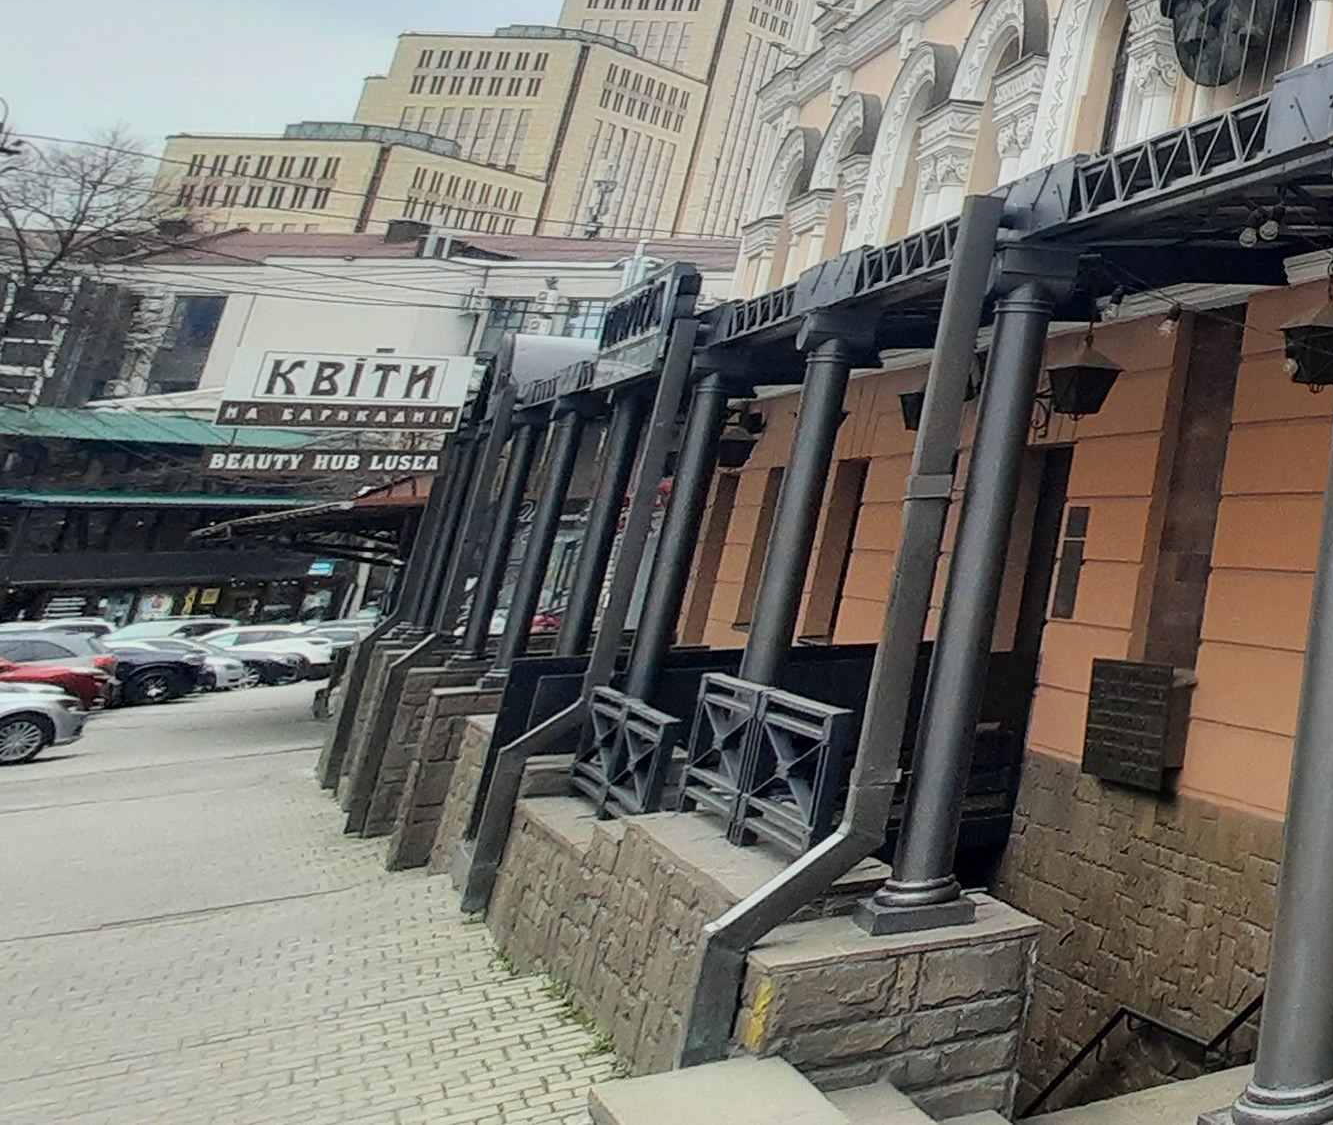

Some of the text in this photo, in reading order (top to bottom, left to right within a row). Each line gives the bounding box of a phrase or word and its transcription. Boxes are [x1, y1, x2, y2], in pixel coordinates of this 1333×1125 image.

[263, 357, 439, 400] КВІТИ
[224, 407, 261, 421] НА
[208, 452, 439, 472] BEAUTY HUB LUSEA
